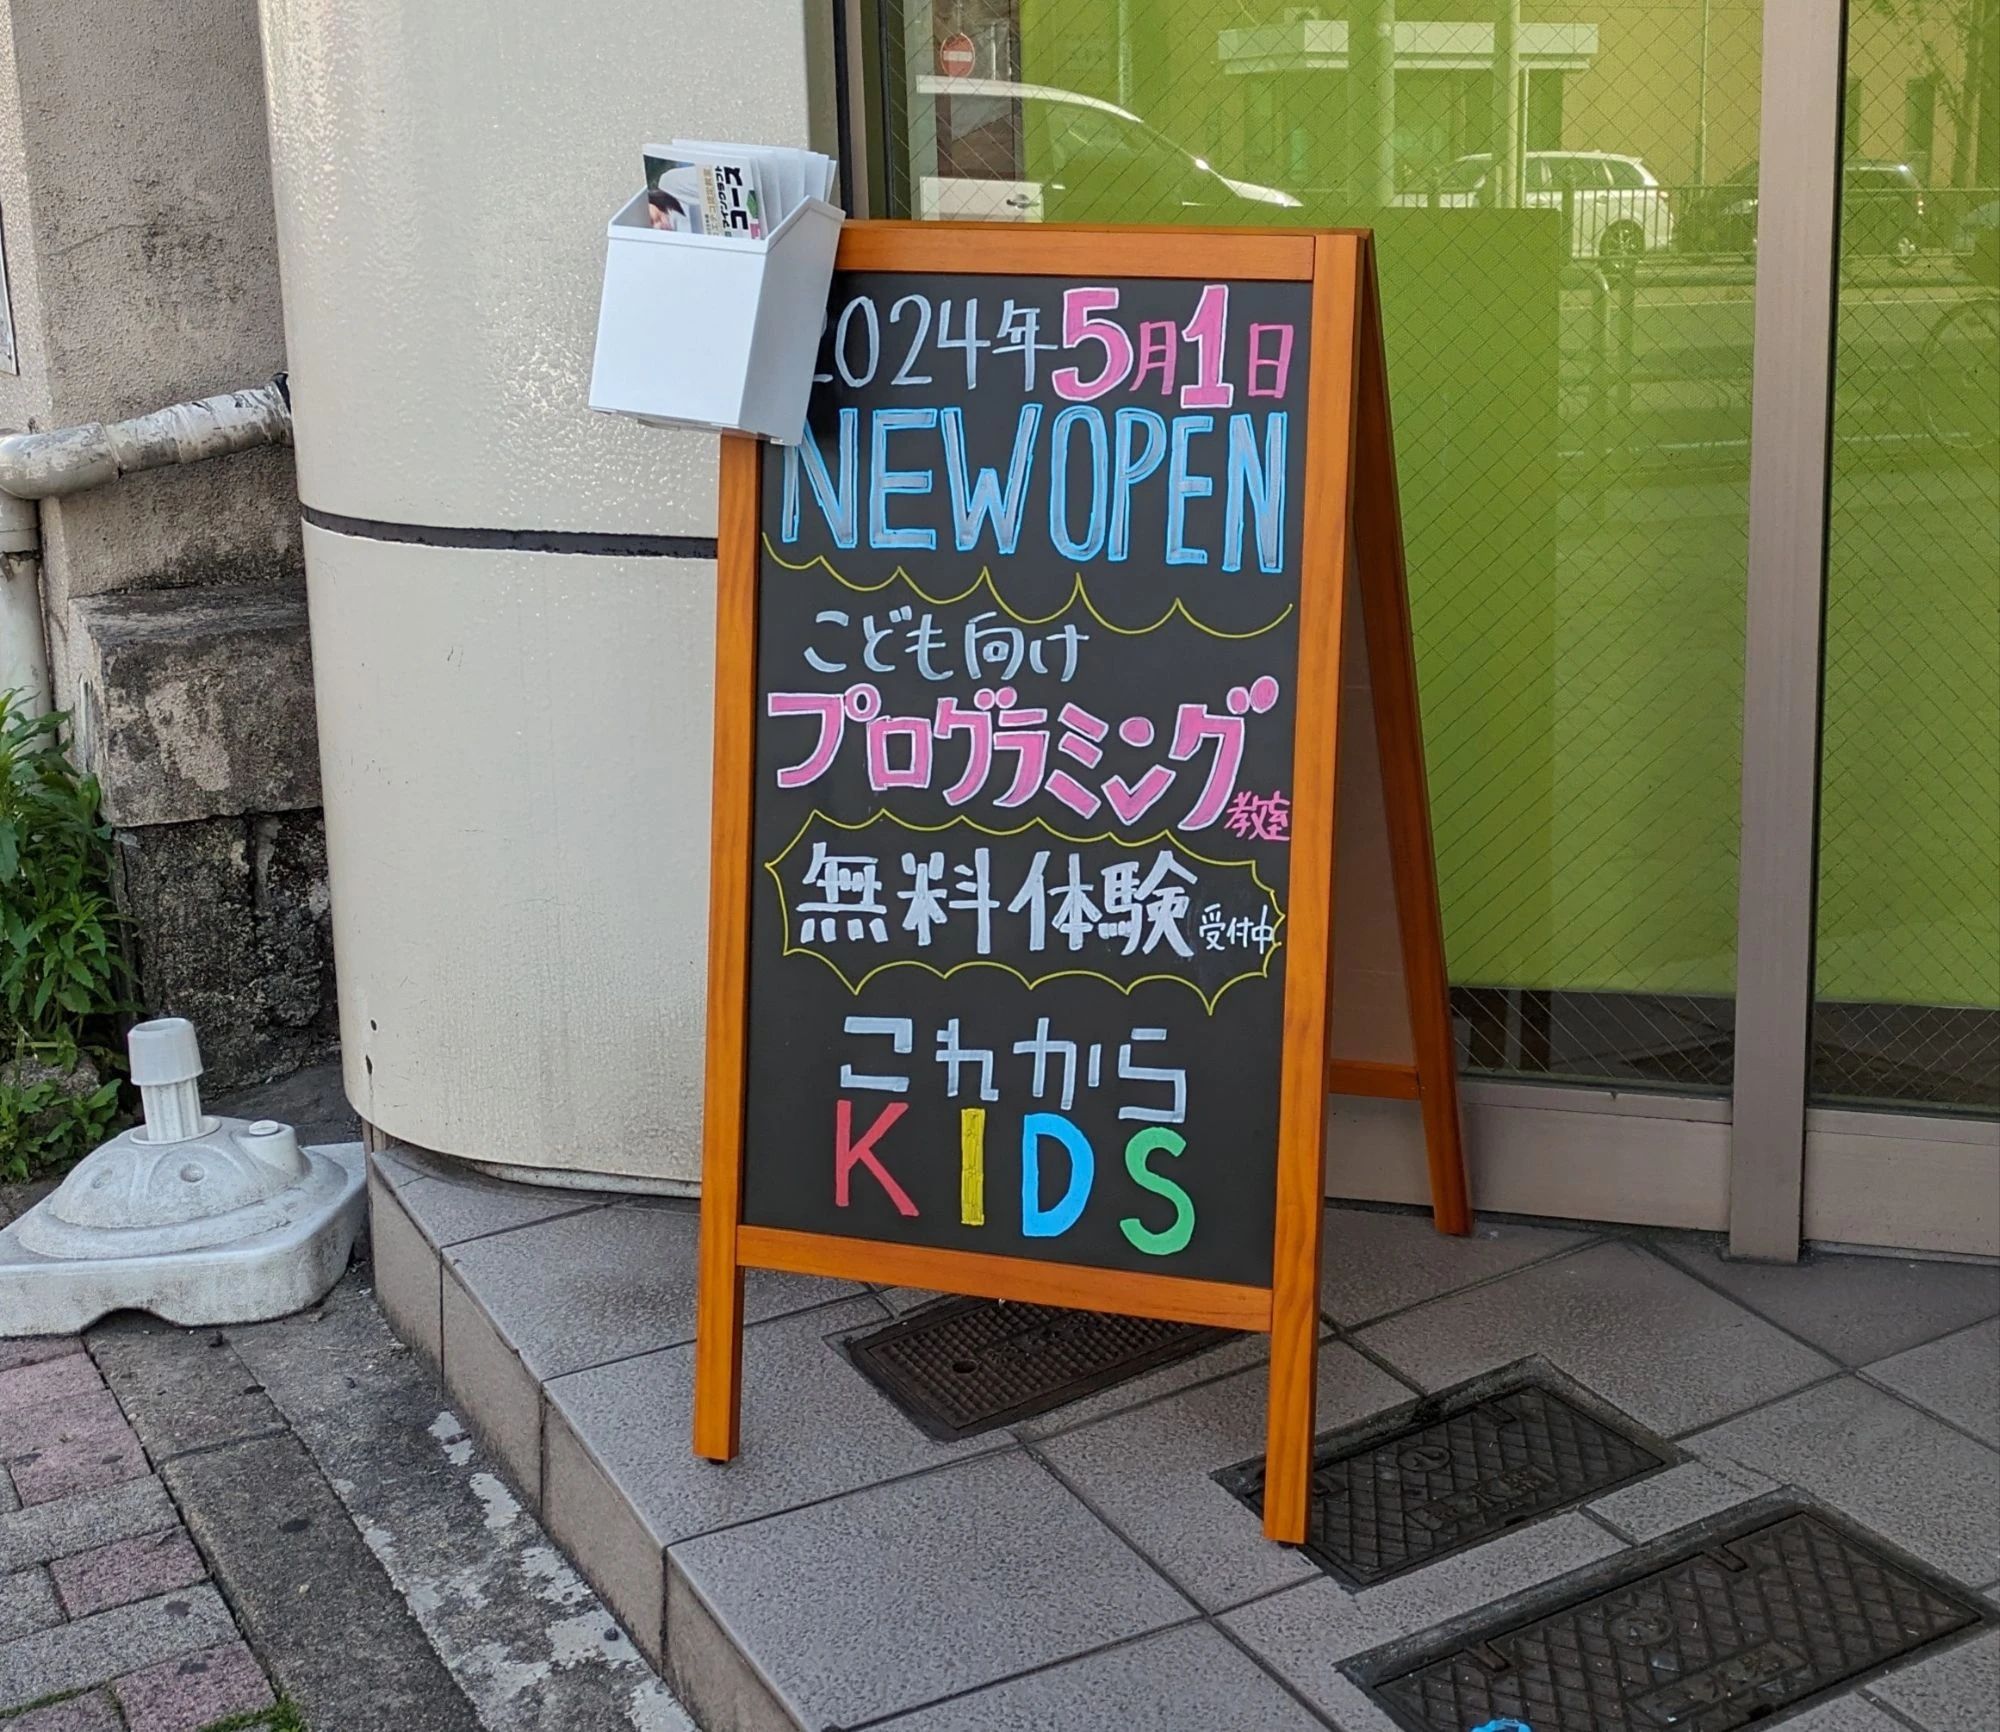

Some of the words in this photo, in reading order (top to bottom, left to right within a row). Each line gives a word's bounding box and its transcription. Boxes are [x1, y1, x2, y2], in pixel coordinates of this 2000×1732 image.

[724, 166, 749, 230] コース
[812, 285, 1294, 408] 024年5月1日
[781, 404, 1042, 554] NEW
[1049, 405, 1288, 573] OPEN
[804, 606, 1089, 681] こども向け
[767, 676, 1279, 831] プログラミング
[796, 841, 1198, 957] 無料体験
[1198, 902, 1276, 955] 受付中
[840, 1016, 1186, 1123] これから
[835, 1100, 1196, 1255] KIDS
